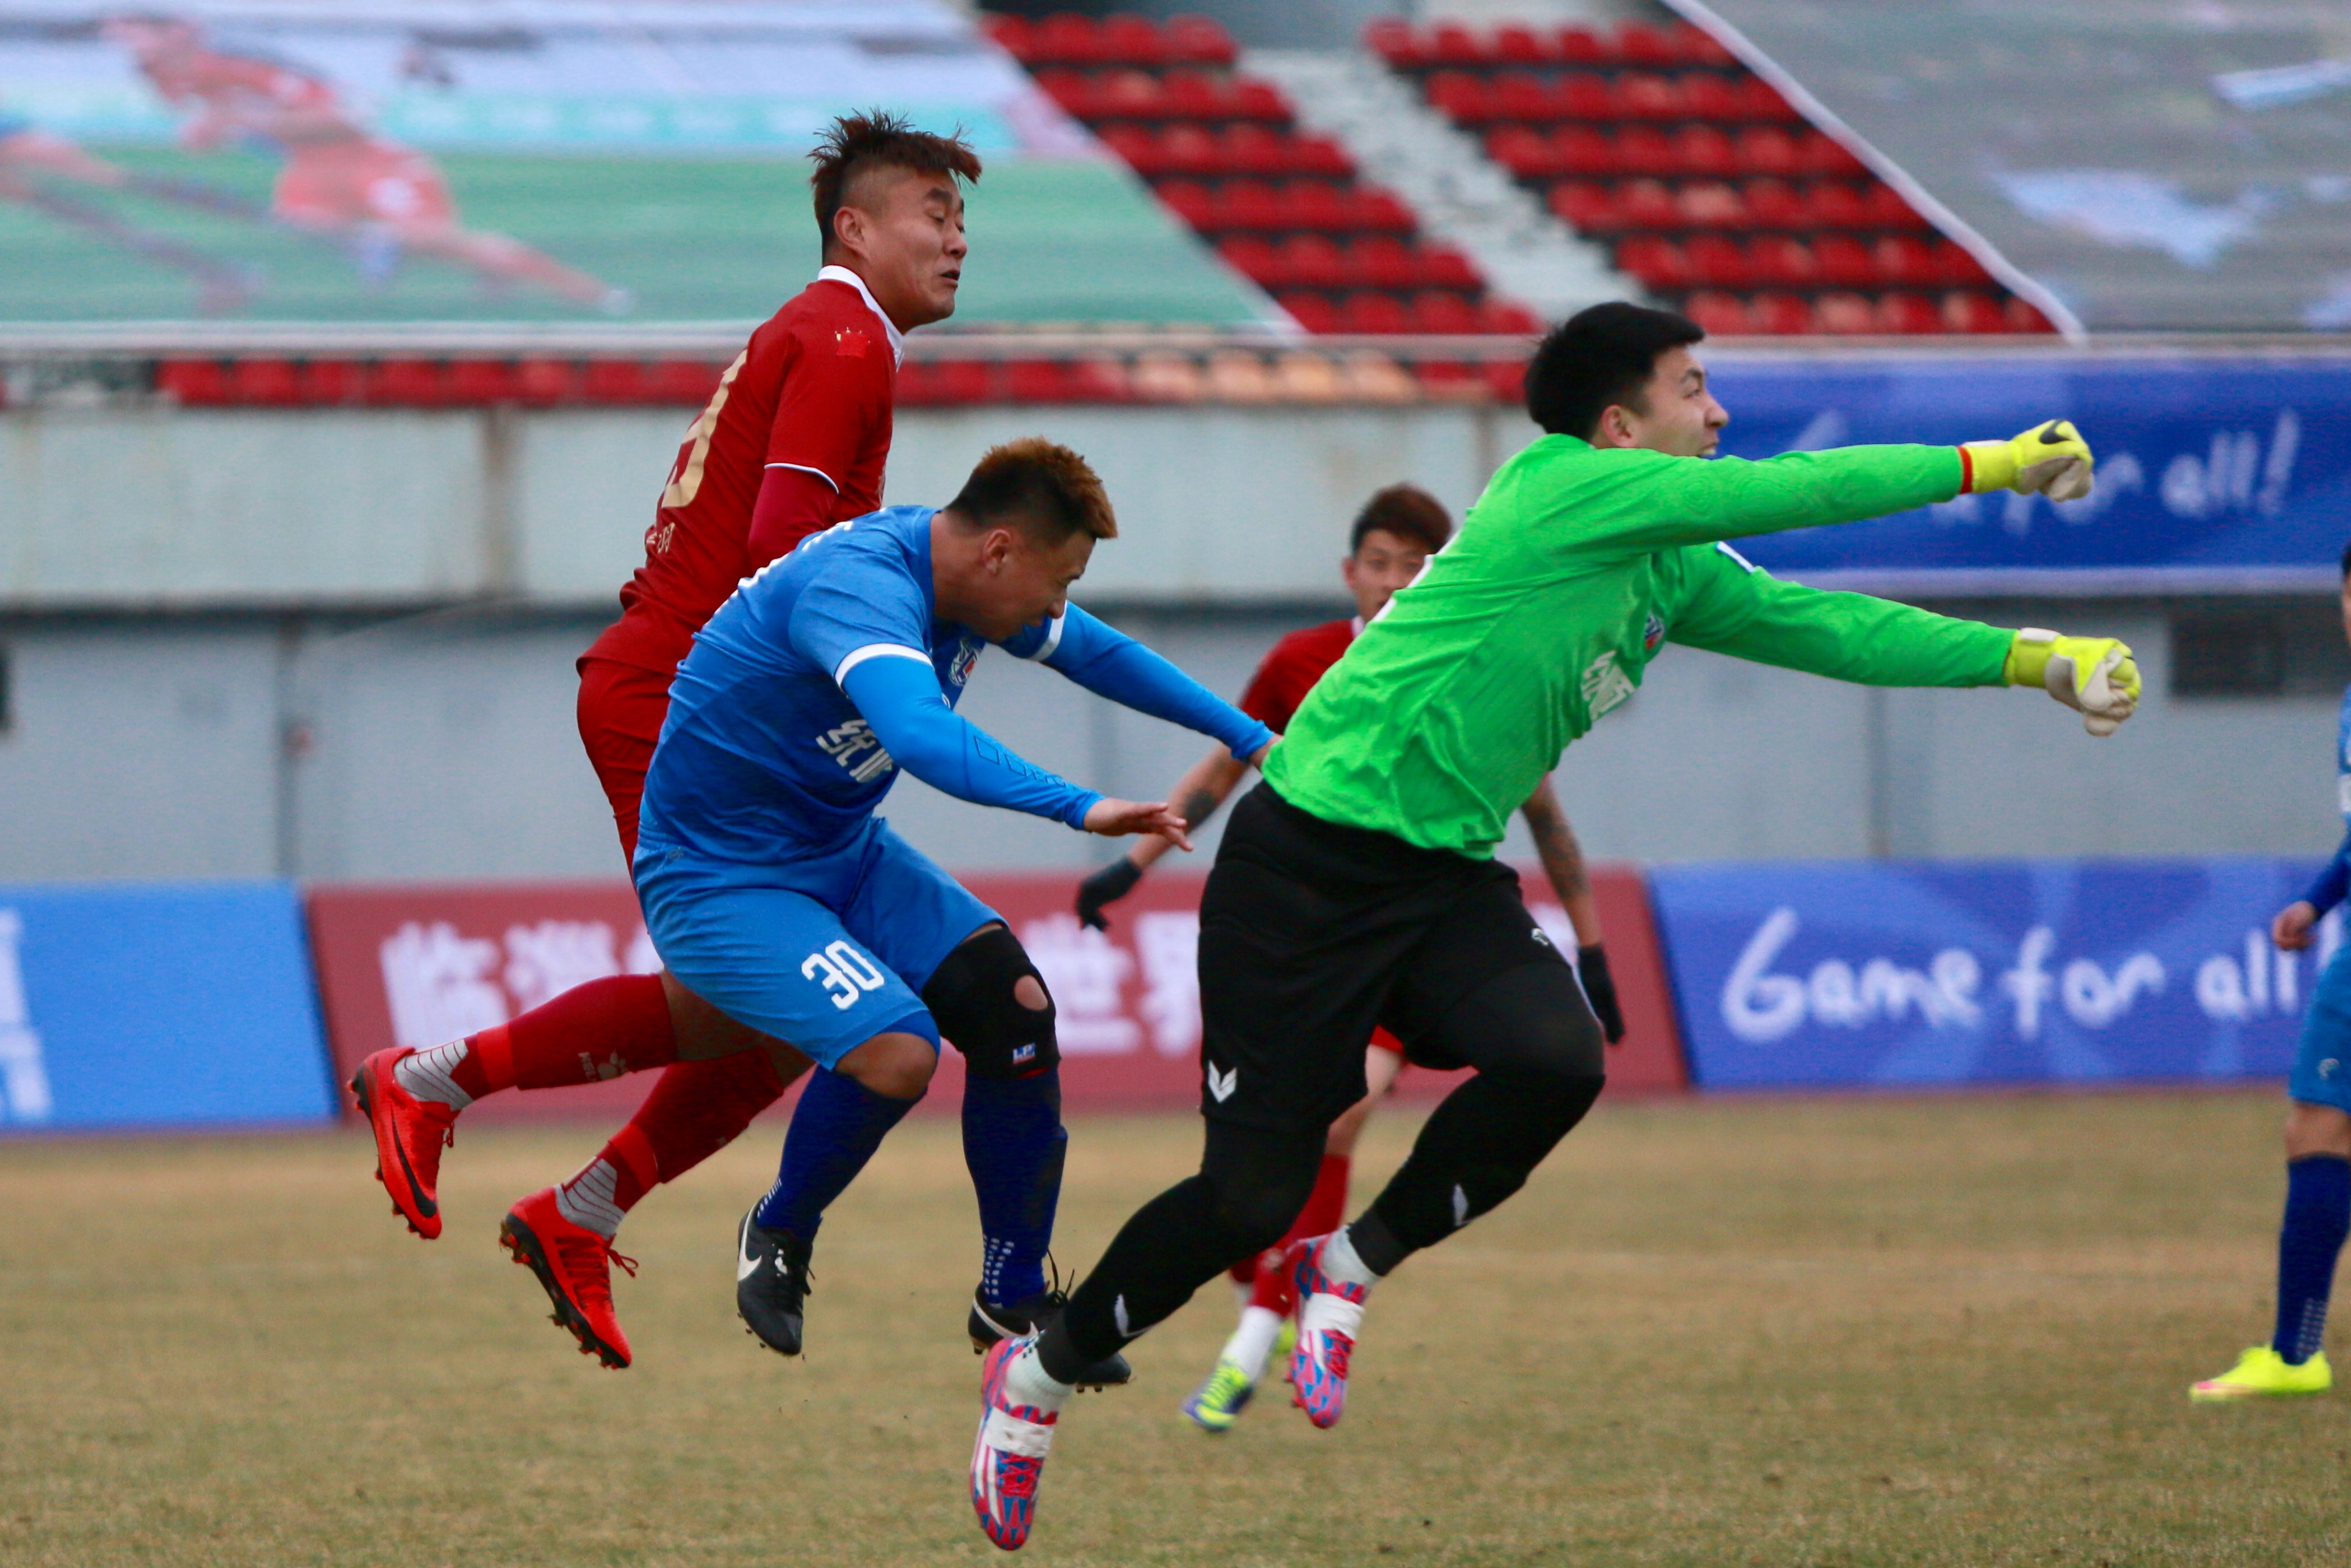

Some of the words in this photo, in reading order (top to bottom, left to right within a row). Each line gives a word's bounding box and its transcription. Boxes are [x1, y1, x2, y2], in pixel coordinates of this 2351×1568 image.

[2159, 406, 2300, 519] all!
[801, 940, 885, 1010] 30
[1720, 905, 1982, 1043] Game
[1999, 926, 2167, 1041] for
